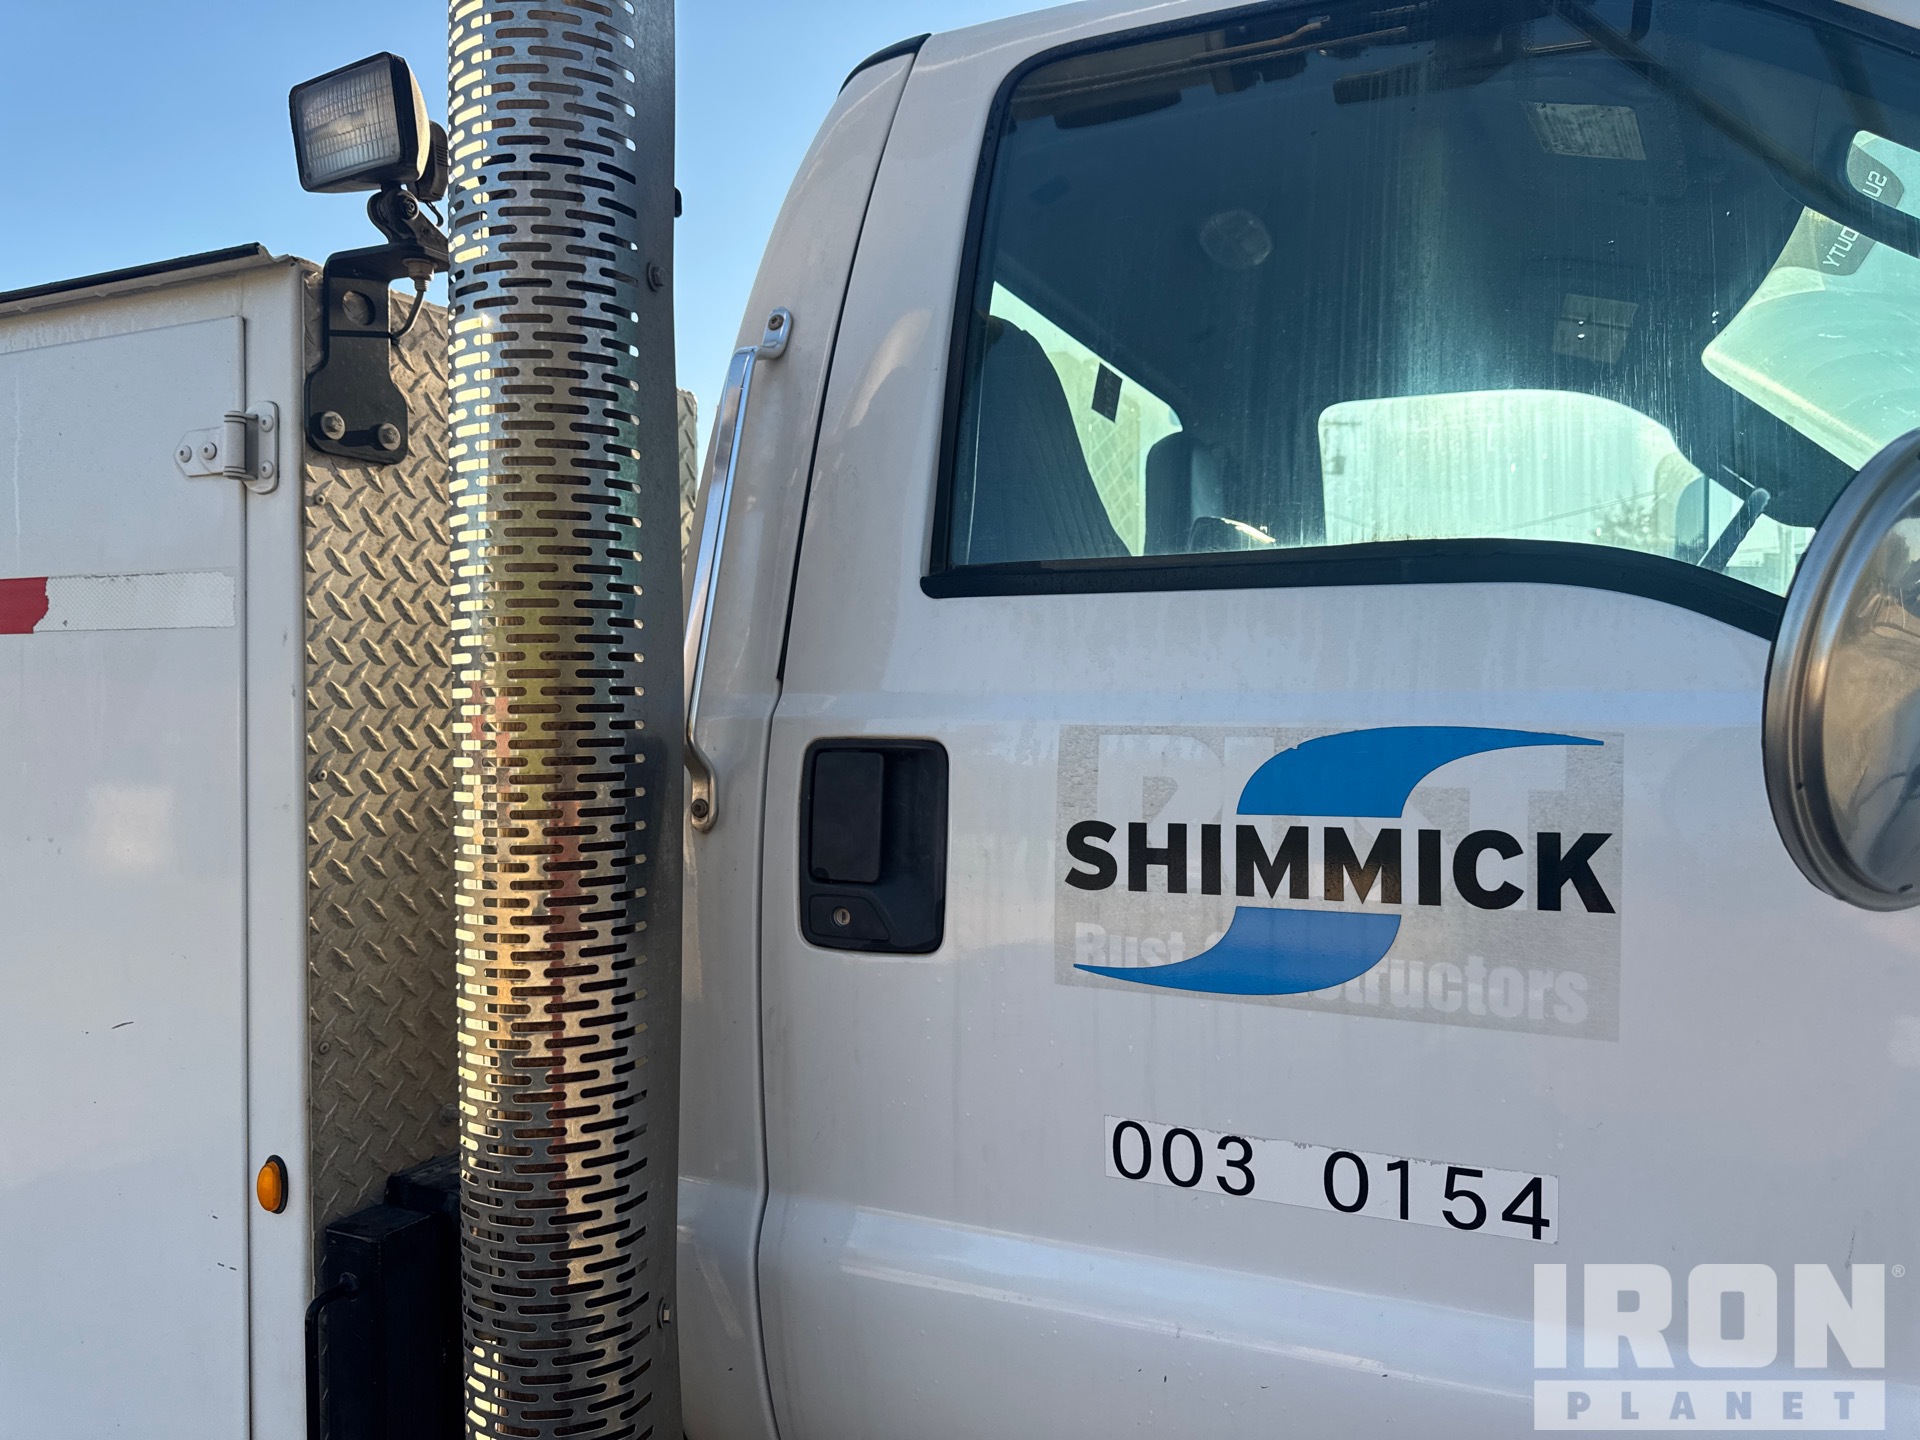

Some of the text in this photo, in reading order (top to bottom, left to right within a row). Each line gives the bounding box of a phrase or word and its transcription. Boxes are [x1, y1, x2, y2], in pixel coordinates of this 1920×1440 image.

[1064, 819, 1616, 914] SHIMMICK
[1112, 1120, 1550, 1240] 003 0154
